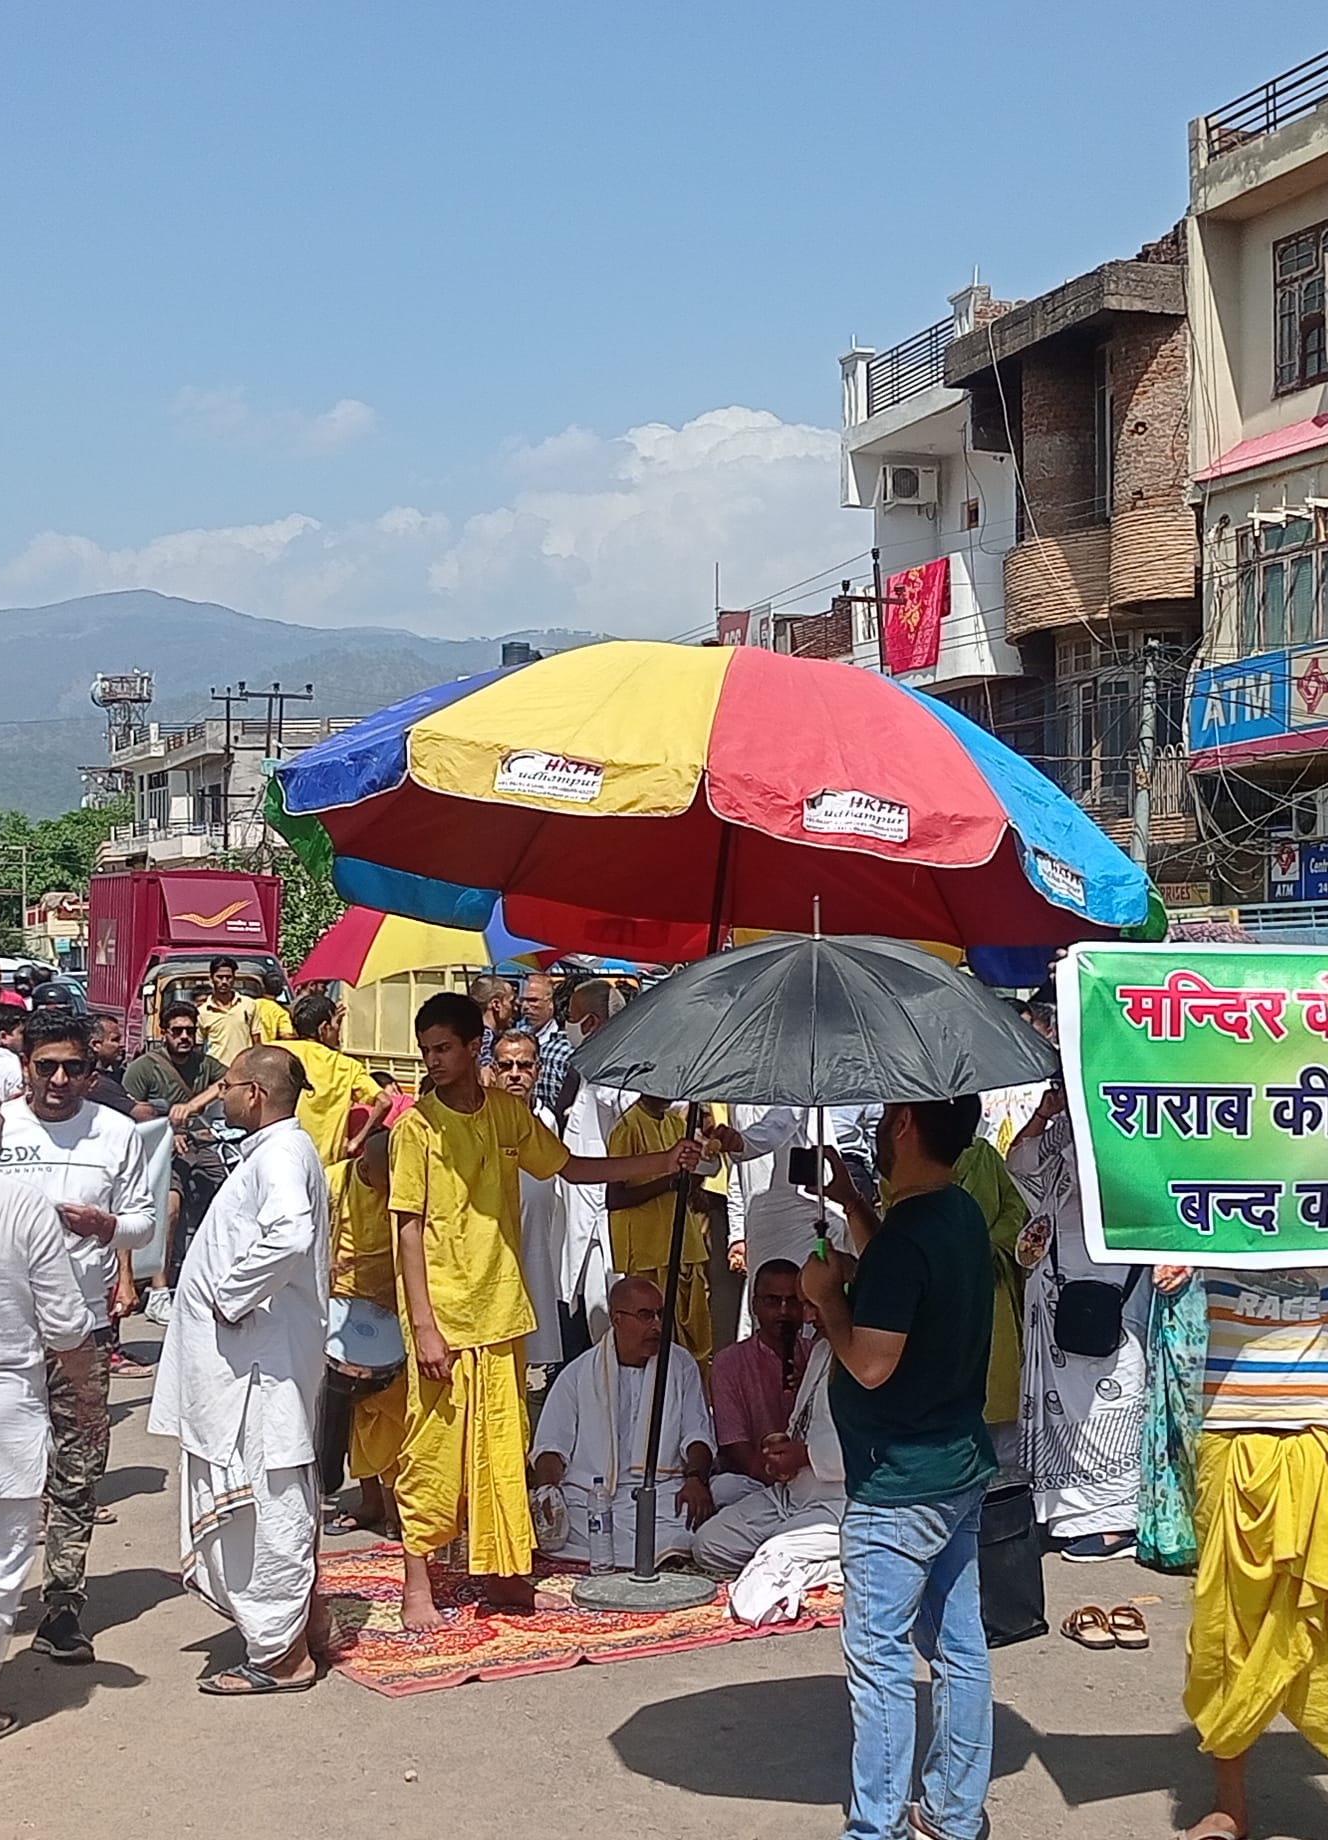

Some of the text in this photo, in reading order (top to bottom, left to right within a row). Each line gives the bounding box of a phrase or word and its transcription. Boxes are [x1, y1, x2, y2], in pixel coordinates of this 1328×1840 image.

[1201, 670, 1272, 731] ATM
[1275, 883, 1294, 898] ATM
[1318, 881, 1328, 893] 24
[1118, 970, 1287, 1041] मन्दिर
[1102, 1083, 1254, 1138] शराब
[1170, 1181, 1283, 1233] बन्द
[1234, 1291, 1322, 1321] RACE
